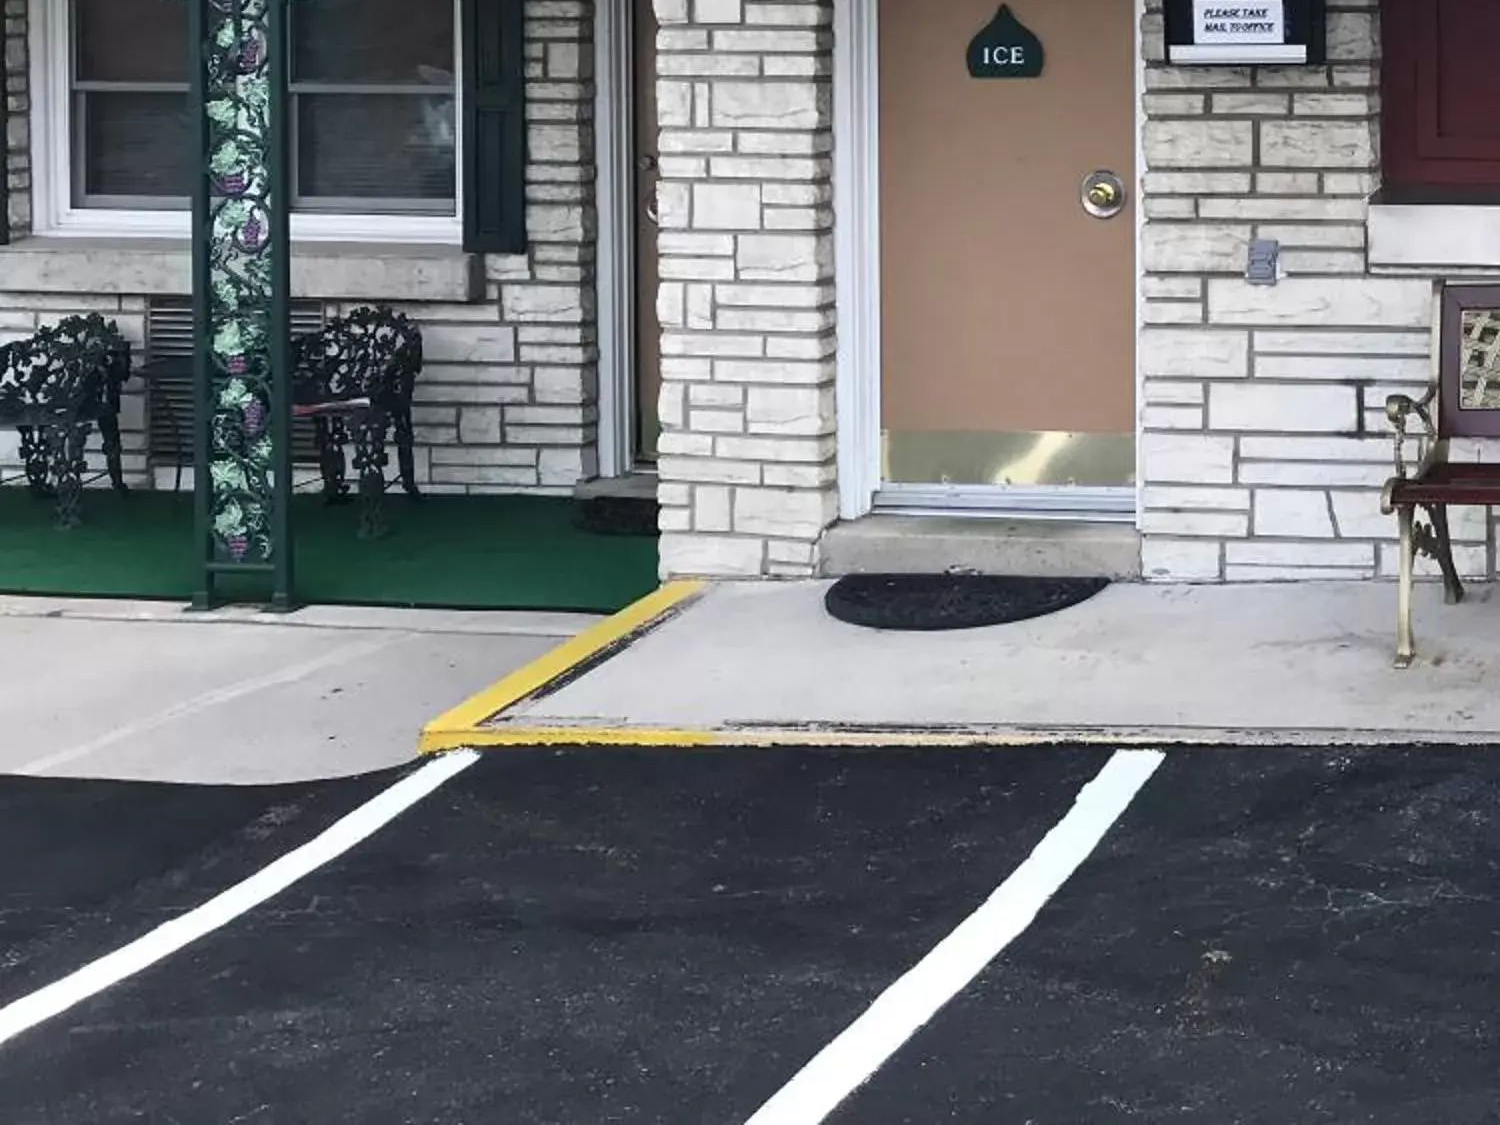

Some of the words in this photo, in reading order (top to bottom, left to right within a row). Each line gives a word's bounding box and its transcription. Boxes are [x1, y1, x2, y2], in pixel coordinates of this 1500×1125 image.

[1203, 8, 1241, 19] PLEASE
[1242, 8, 1269, 19] TAKE
[983, 46, 1025, 64] ICE
